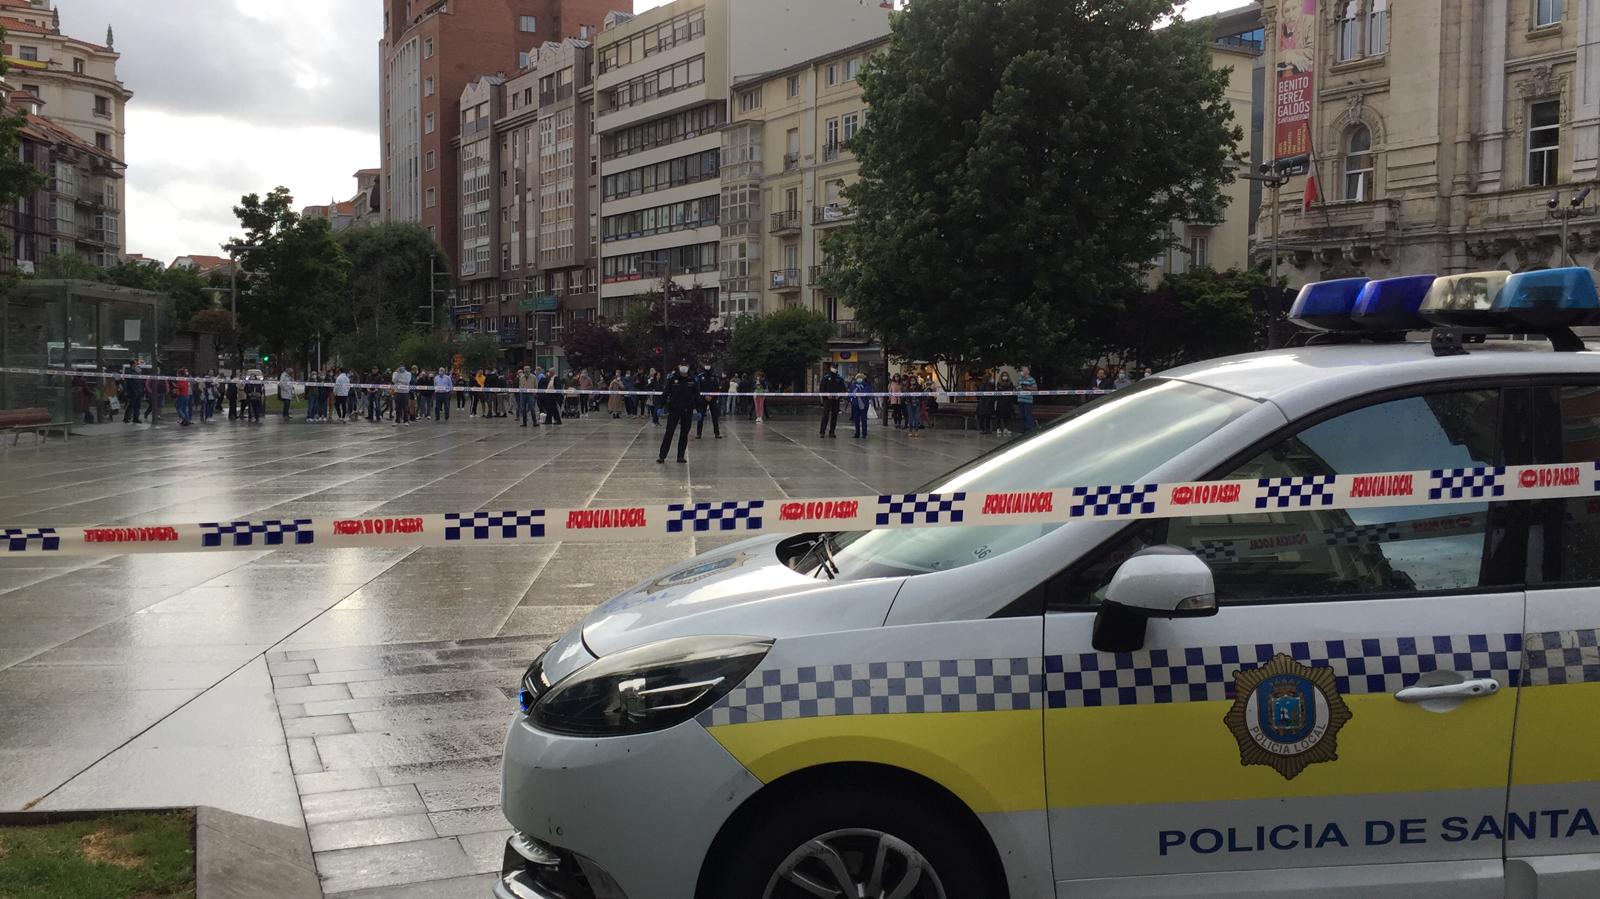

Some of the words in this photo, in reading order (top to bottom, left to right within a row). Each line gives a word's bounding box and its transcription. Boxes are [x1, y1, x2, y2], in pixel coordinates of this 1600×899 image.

[1278, 76, 1309, 93] BENITO
[1350, 476, 1386, 498] POLICIA
[1387, 474, 1413, 496] LOCAL
[1539, 468, 1552, 487] NO
[1553, 467, 1580, 486] PASAR
[1194, 485, 1208, 504] NO
[1209, 484, 1240, 503] PASAR
[1250, 726, 1290, 754] POLICIA
[1294, 723, 1326, 752] LOCAL
[1158, 822, 1349, 856] POLICIA
[1365, 818, 1427, 846] DE
